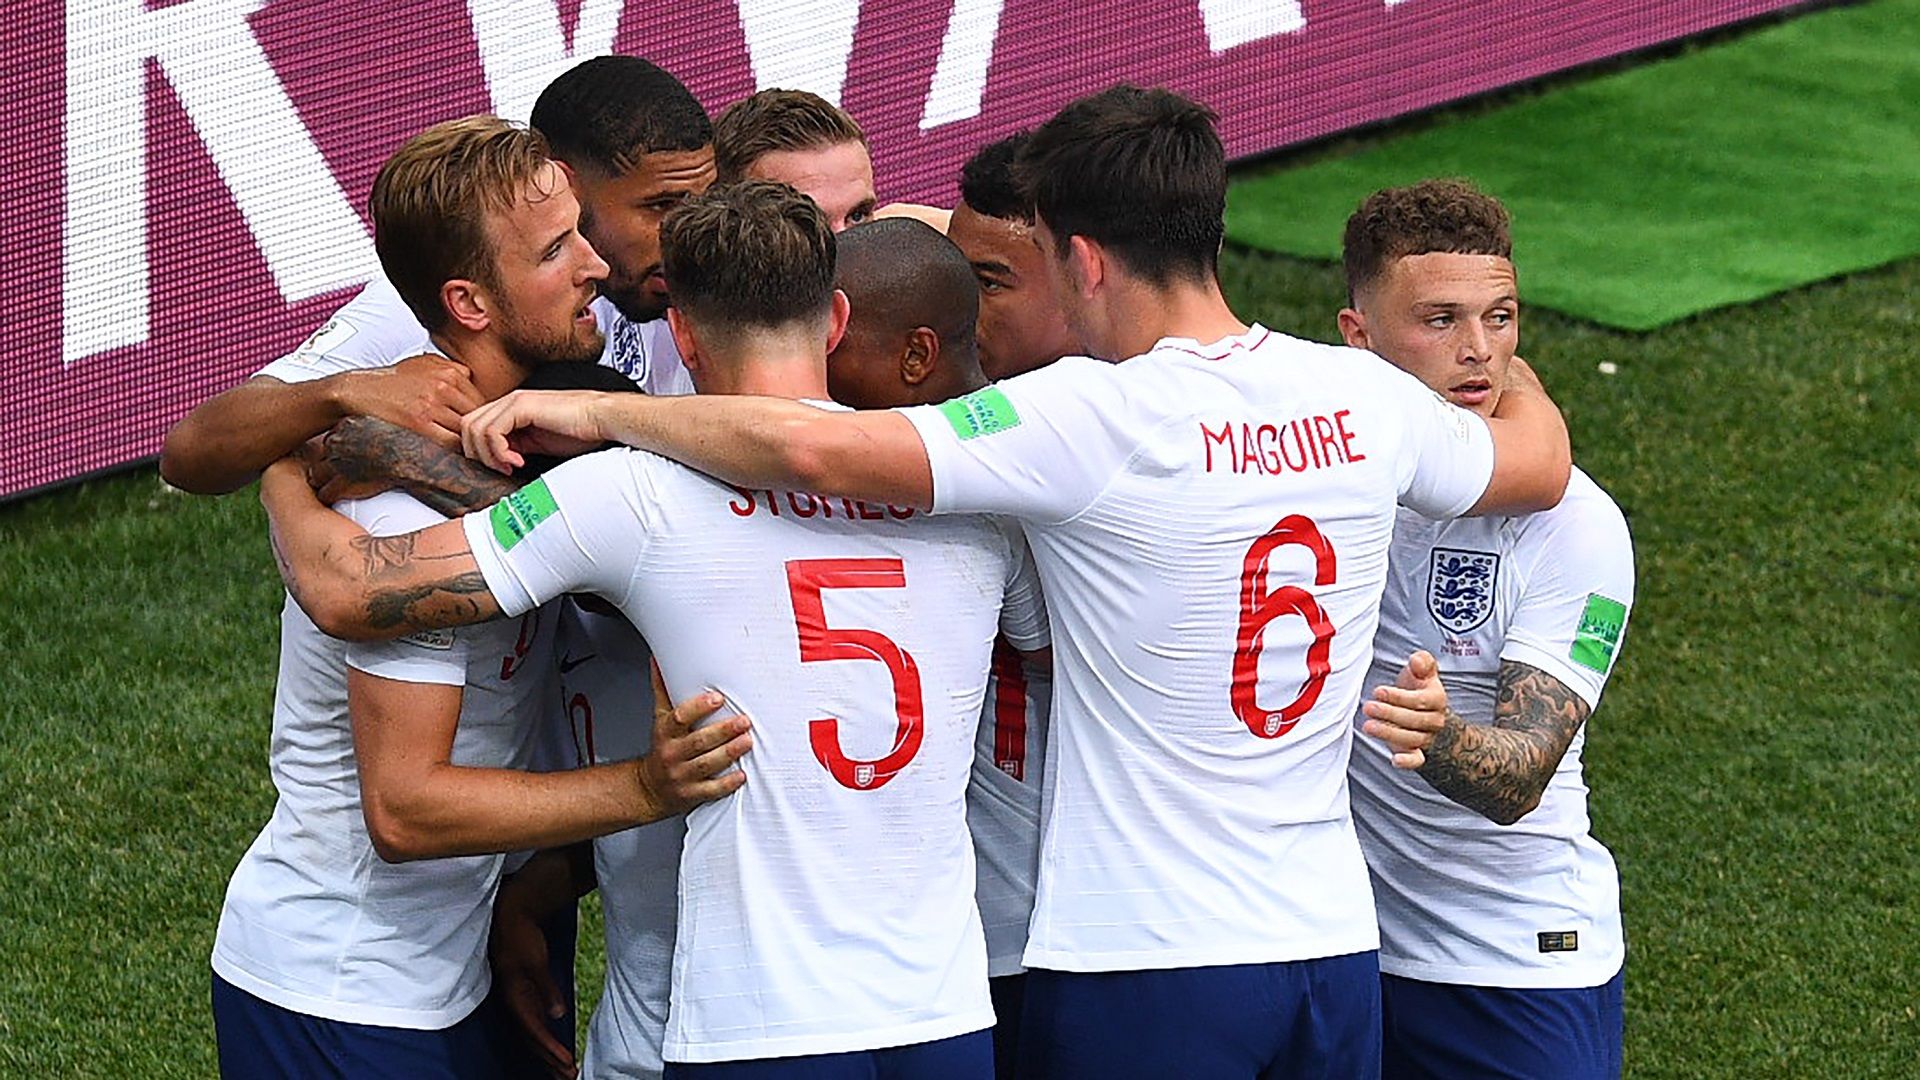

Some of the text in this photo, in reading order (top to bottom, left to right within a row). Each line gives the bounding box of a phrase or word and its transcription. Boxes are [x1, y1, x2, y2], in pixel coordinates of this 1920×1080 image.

[1199, 409, 1366, 476] MAGUIRE
[786, 559, 924, 791] 5
[1230, 514, 1336, 739] 6
